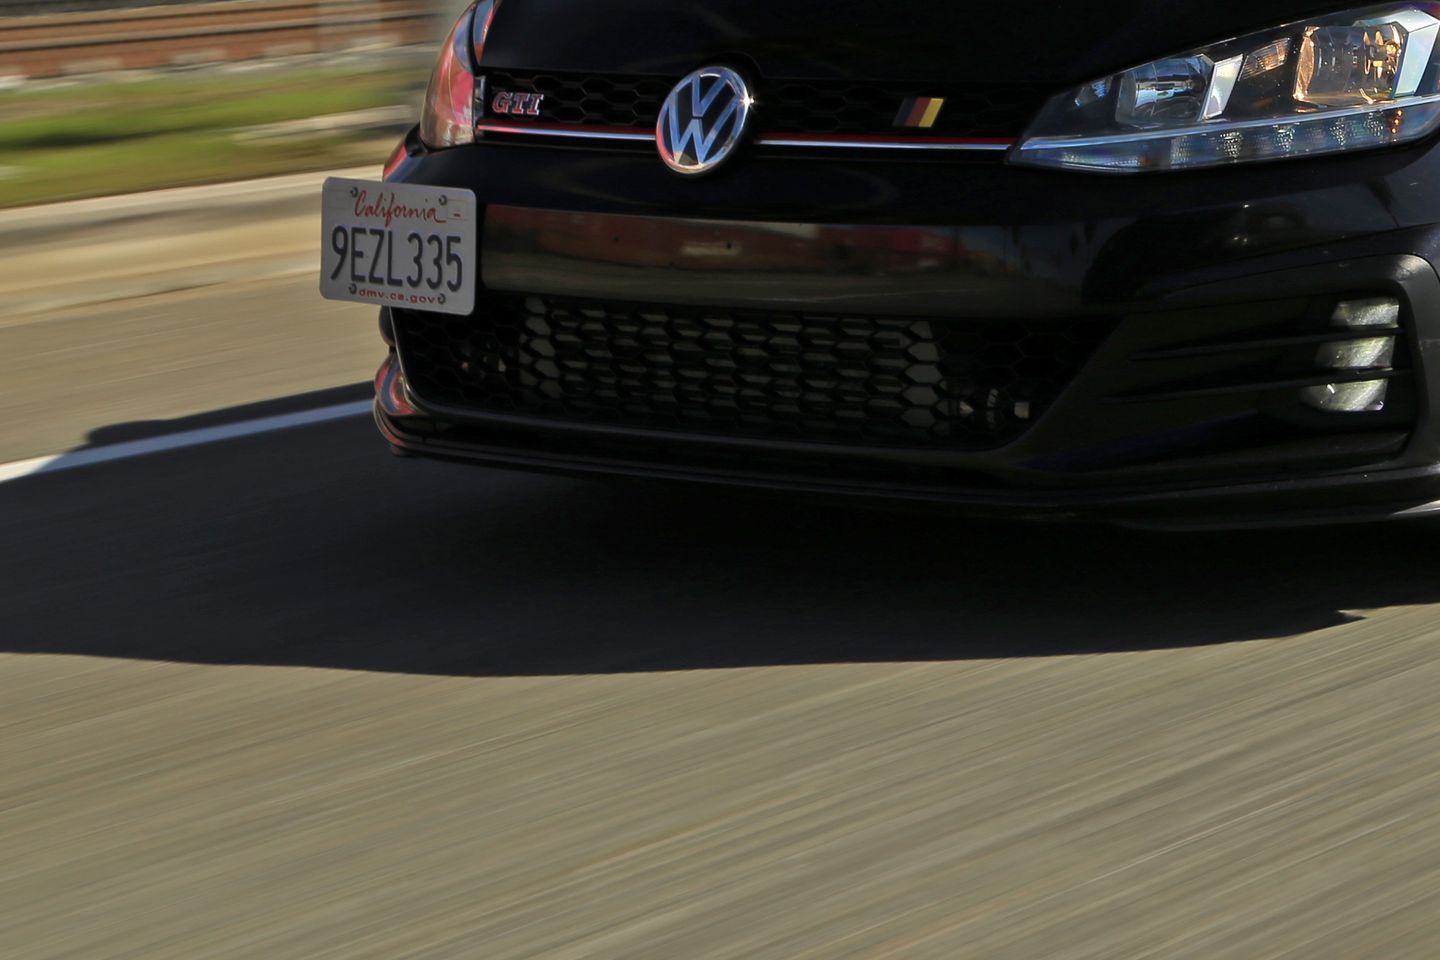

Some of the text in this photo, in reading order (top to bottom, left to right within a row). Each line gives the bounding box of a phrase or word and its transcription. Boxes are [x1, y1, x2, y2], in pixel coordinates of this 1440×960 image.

[491, 91, 544, 116] GTI
[354, 190, 447, 227] California
[330, 225, 463, 292] 9EZL335
[358, 289, 436, 305] dmv.ca.gov
